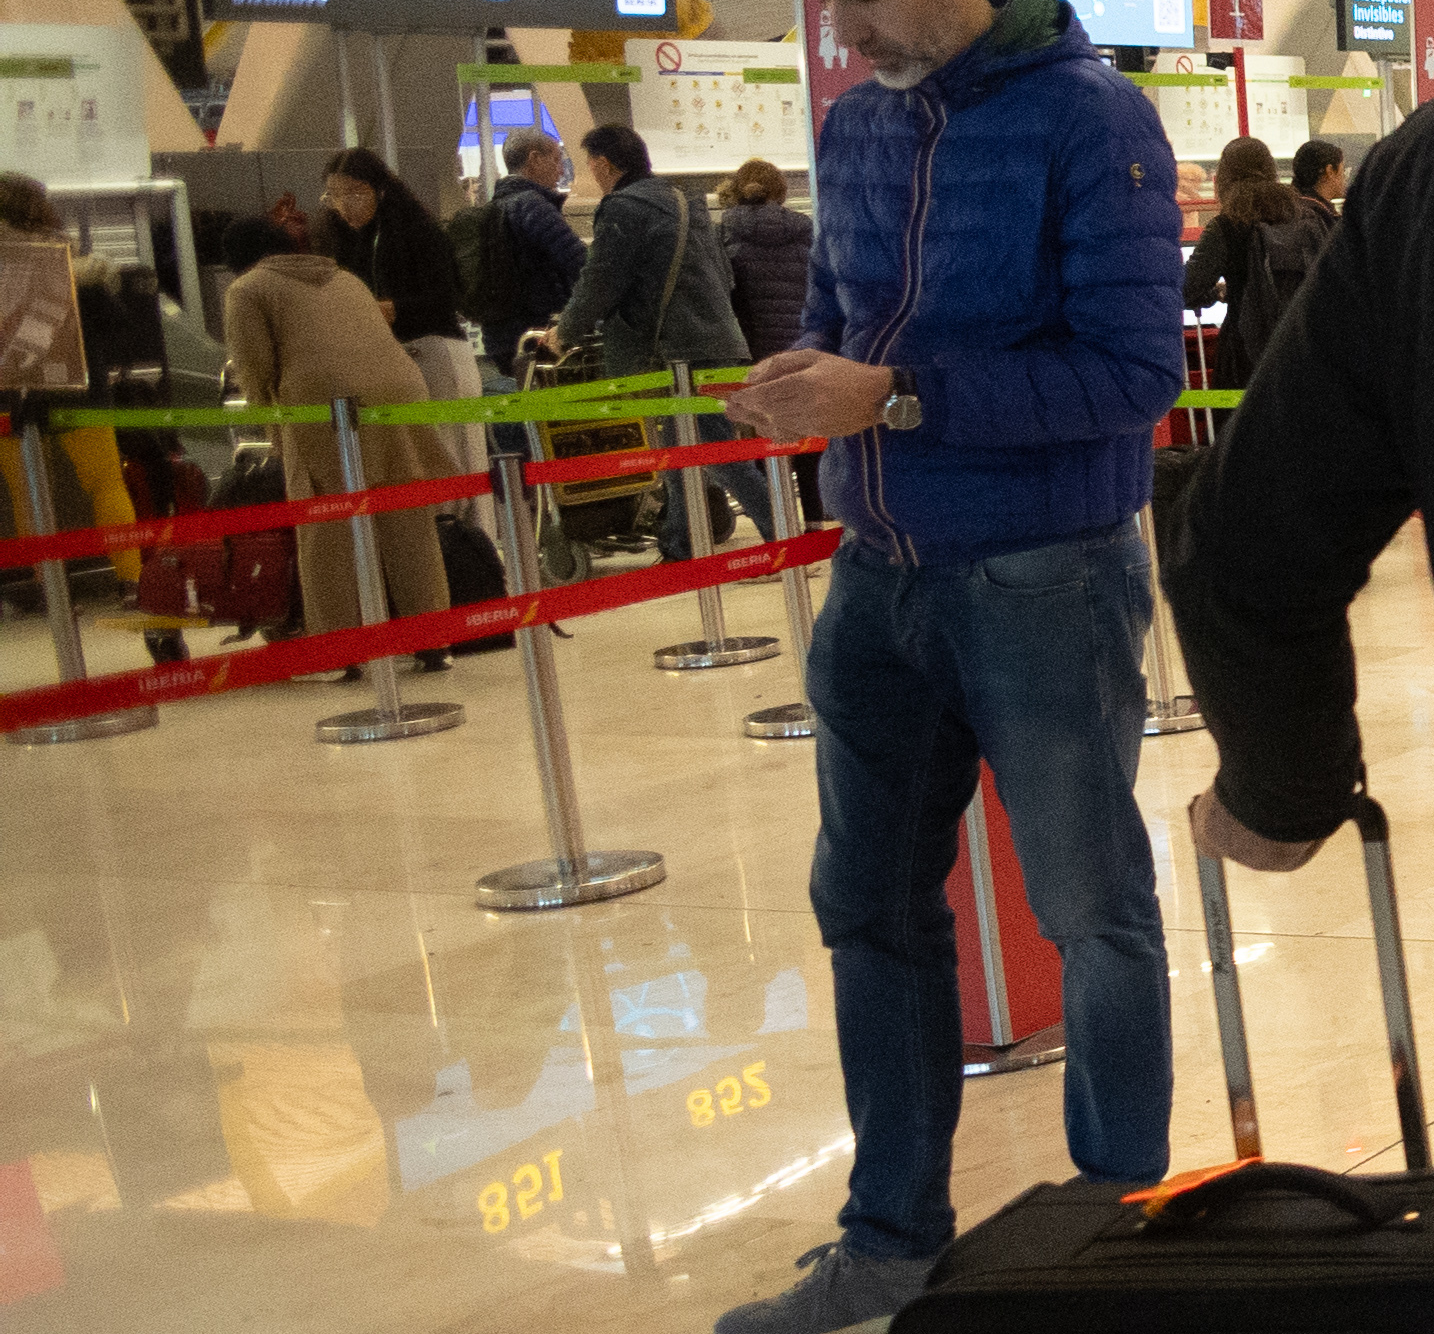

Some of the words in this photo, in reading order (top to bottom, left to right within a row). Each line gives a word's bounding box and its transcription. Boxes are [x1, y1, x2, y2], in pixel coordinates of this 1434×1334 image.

[1354, 5, 1404, 24] invisibles
[727, 552, 771, 571] IBERIA
[466, 607, 520, 627] IBERIA
